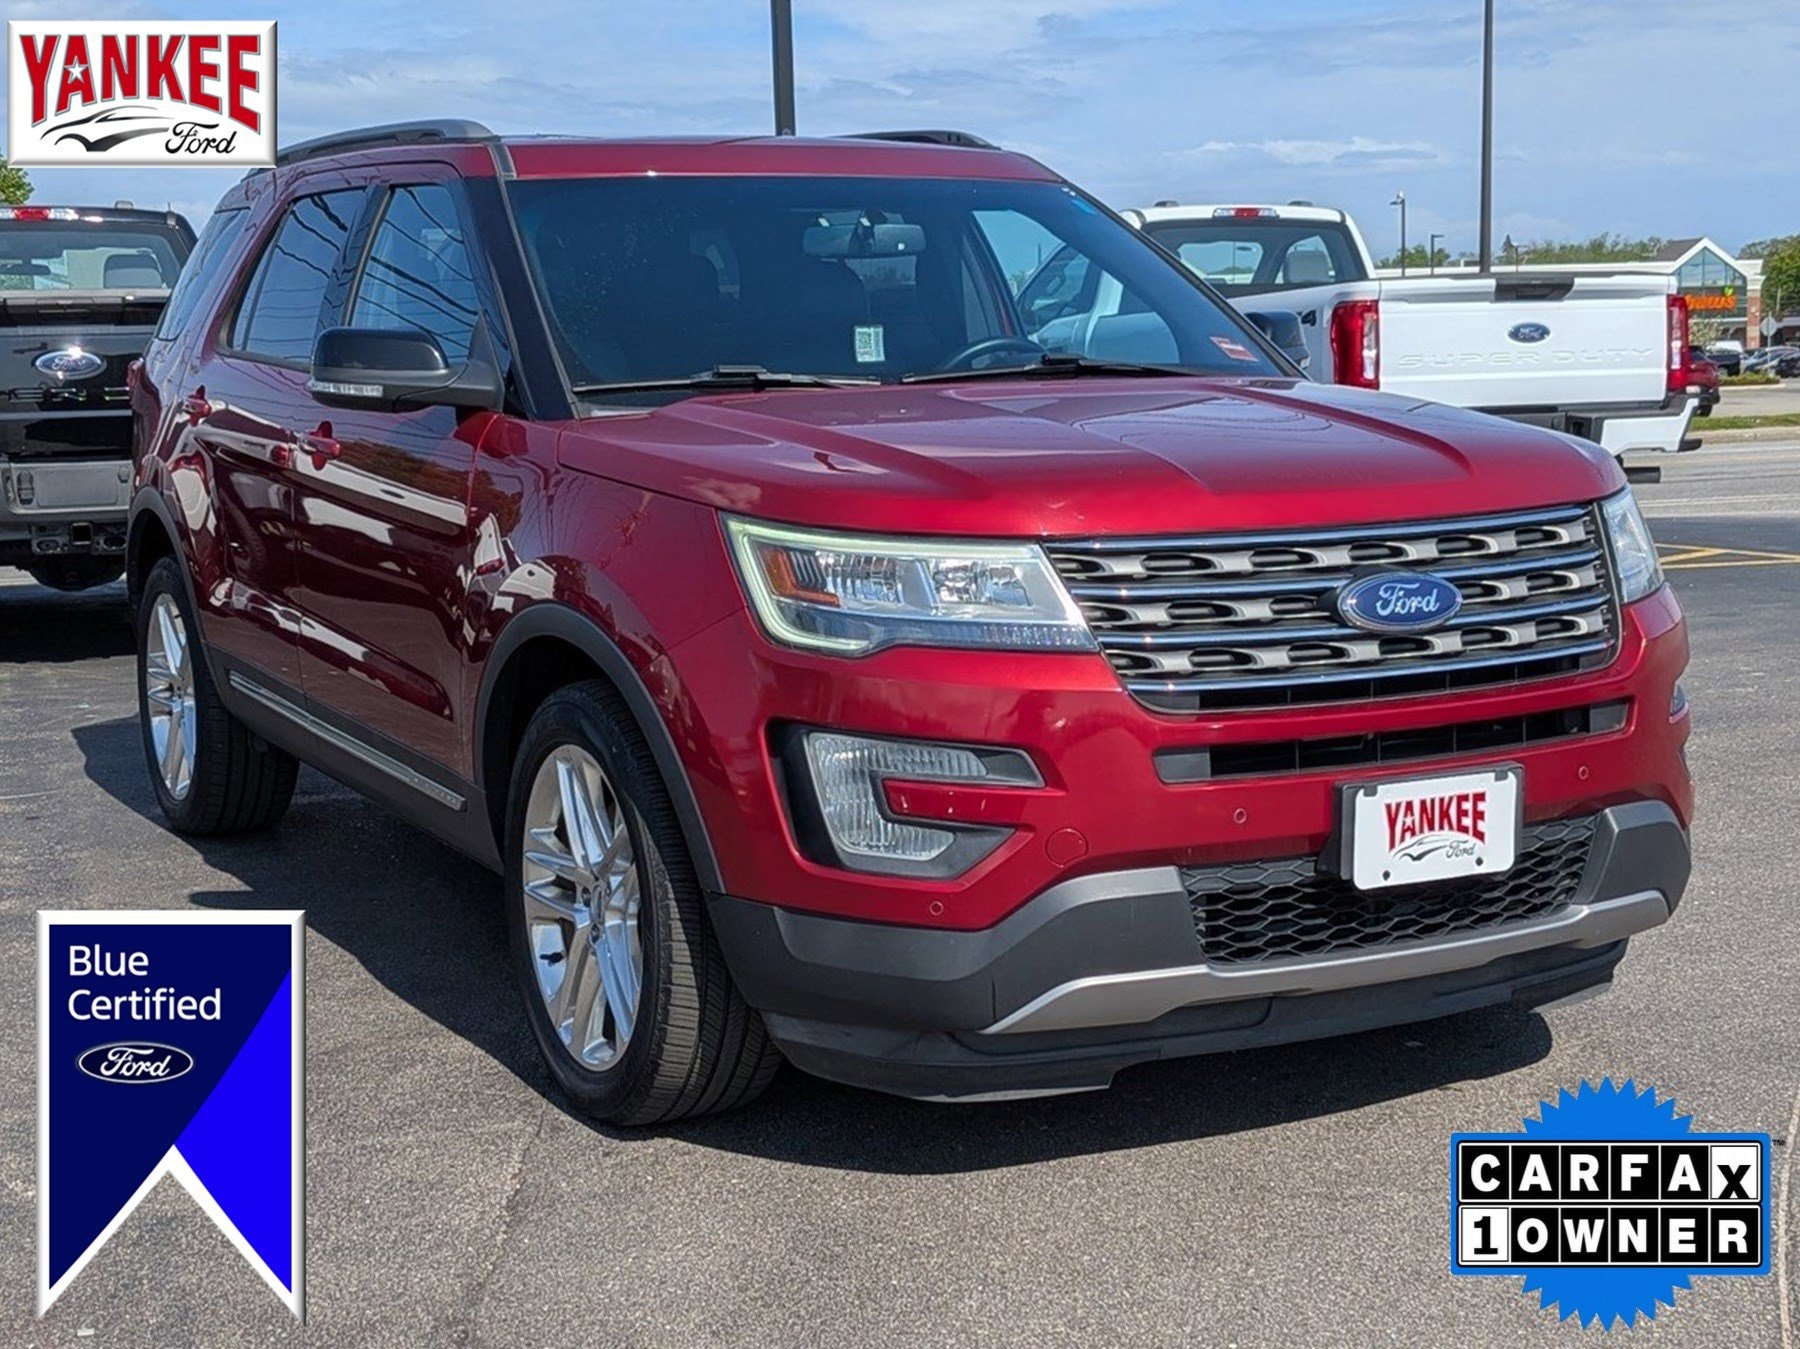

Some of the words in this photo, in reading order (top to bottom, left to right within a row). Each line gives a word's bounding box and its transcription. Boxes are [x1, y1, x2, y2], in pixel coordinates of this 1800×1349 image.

[1398, 350, 1541, 369] SUPER
[1552, 347, 1654, 364] DUTY
[1375, 582, 1440, 616] Ford
[1384, 790, 1487, 853] YANKEE
[1445, 840, 1477, 859] Ford
